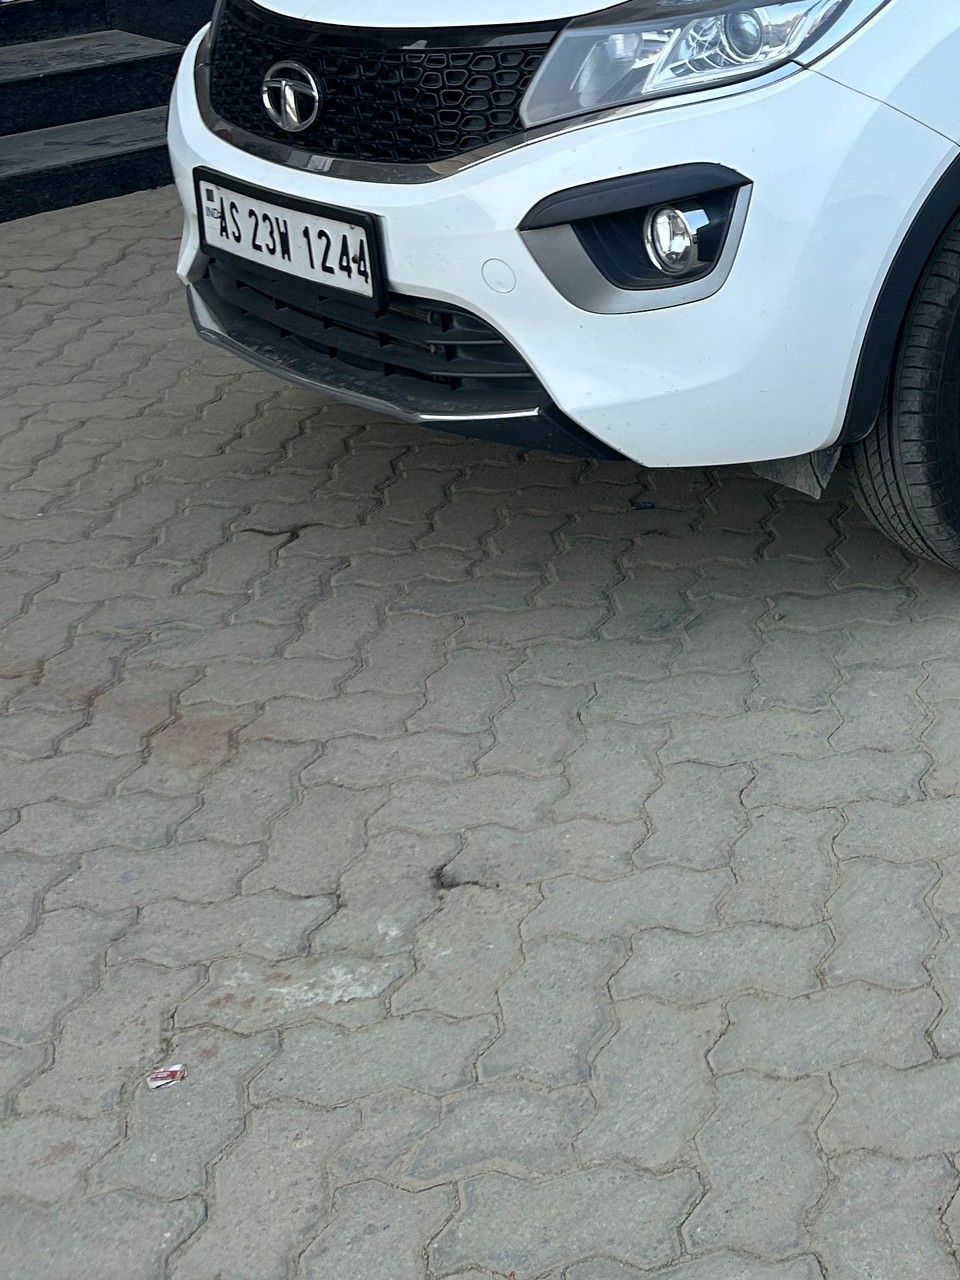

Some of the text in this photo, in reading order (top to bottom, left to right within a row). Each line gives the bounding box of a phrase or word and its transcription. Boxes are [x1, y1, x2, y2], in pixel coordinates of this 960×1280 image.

[220, 197, 369, 284] AS 23W 1244
